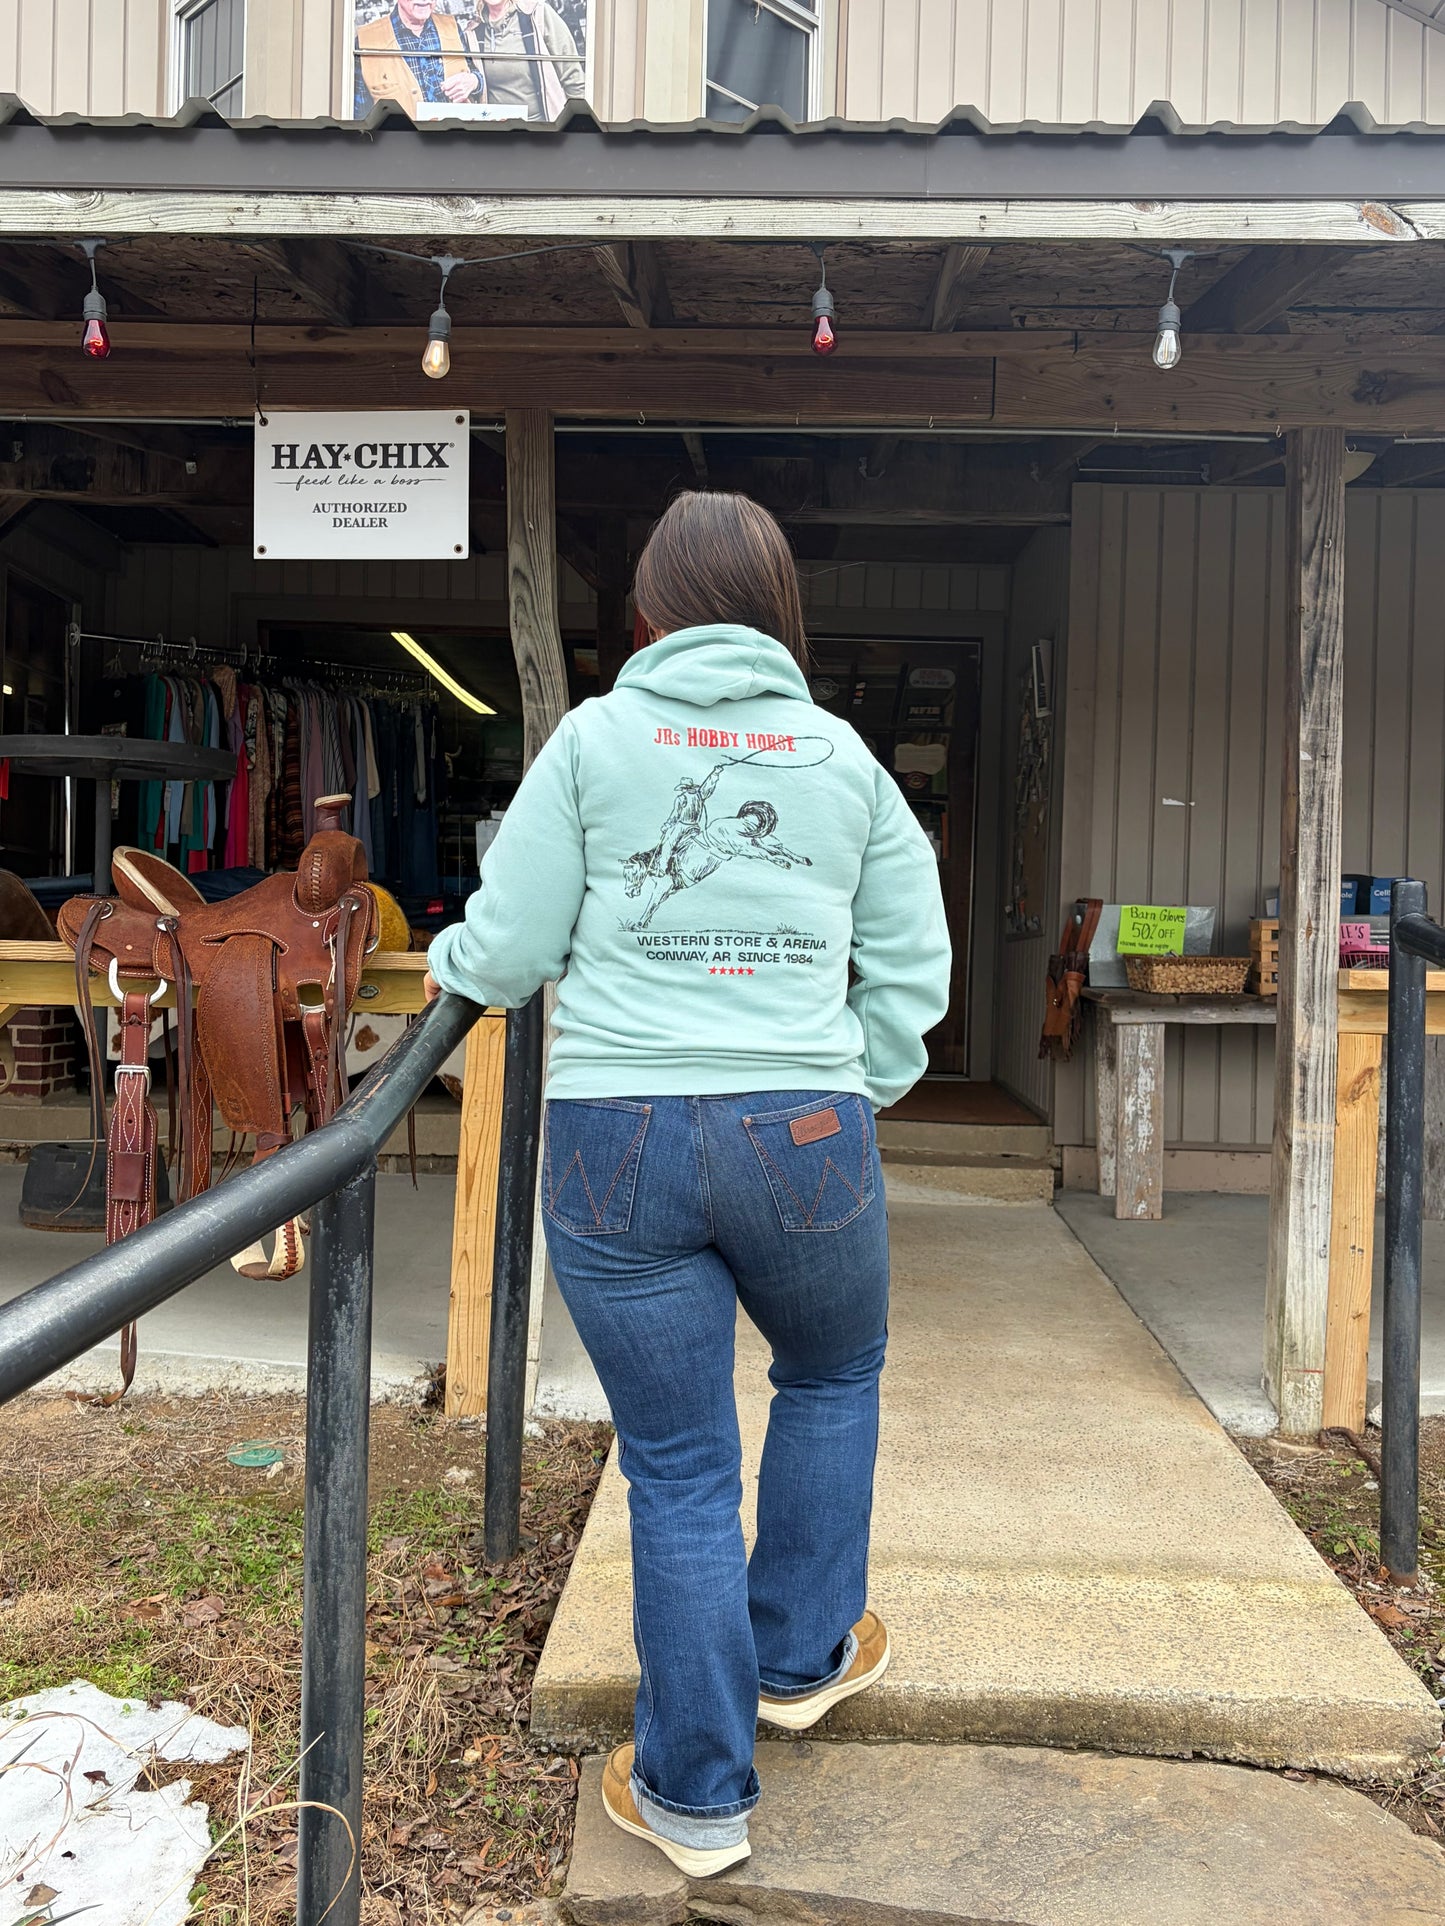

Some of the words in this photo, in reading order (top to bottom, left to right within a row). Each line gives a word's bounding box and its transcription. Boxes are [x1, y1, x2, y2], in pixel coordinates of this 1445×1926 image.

[271, 443, 348, 470] HAY
[295, 474, 332, 491] feed
[338, 474, 368, 486] like
[391, 475, 422, 486] boss
[312, 502, 408, 514] AUTHORIZED
[332, 517, 388, 528] DEALER
[654, 728, 681, 746] JRs
[687, 727, 740, 748] HOBBY
[745, 733, 797, 752] HORSE
[1130, 906, 1156, 920] Barn
[1159, 908, 1186, 923] Gloves
[1132, 921, 1159, 940] 50%
[1158, 928, 1176, 939] OFF
[637, 935, 710, 946] WESTERN
[715, 936, 762, 947] STORE
[767, 937, 778, 948] &
[782, 938, 827, 950] ARENA
[646, 951, 709, 963] CONWAY,
[712, 951, 731, 962] AR
[737, 952, 781, 963] SINCE
[784, 953, 814, 964] 1984
